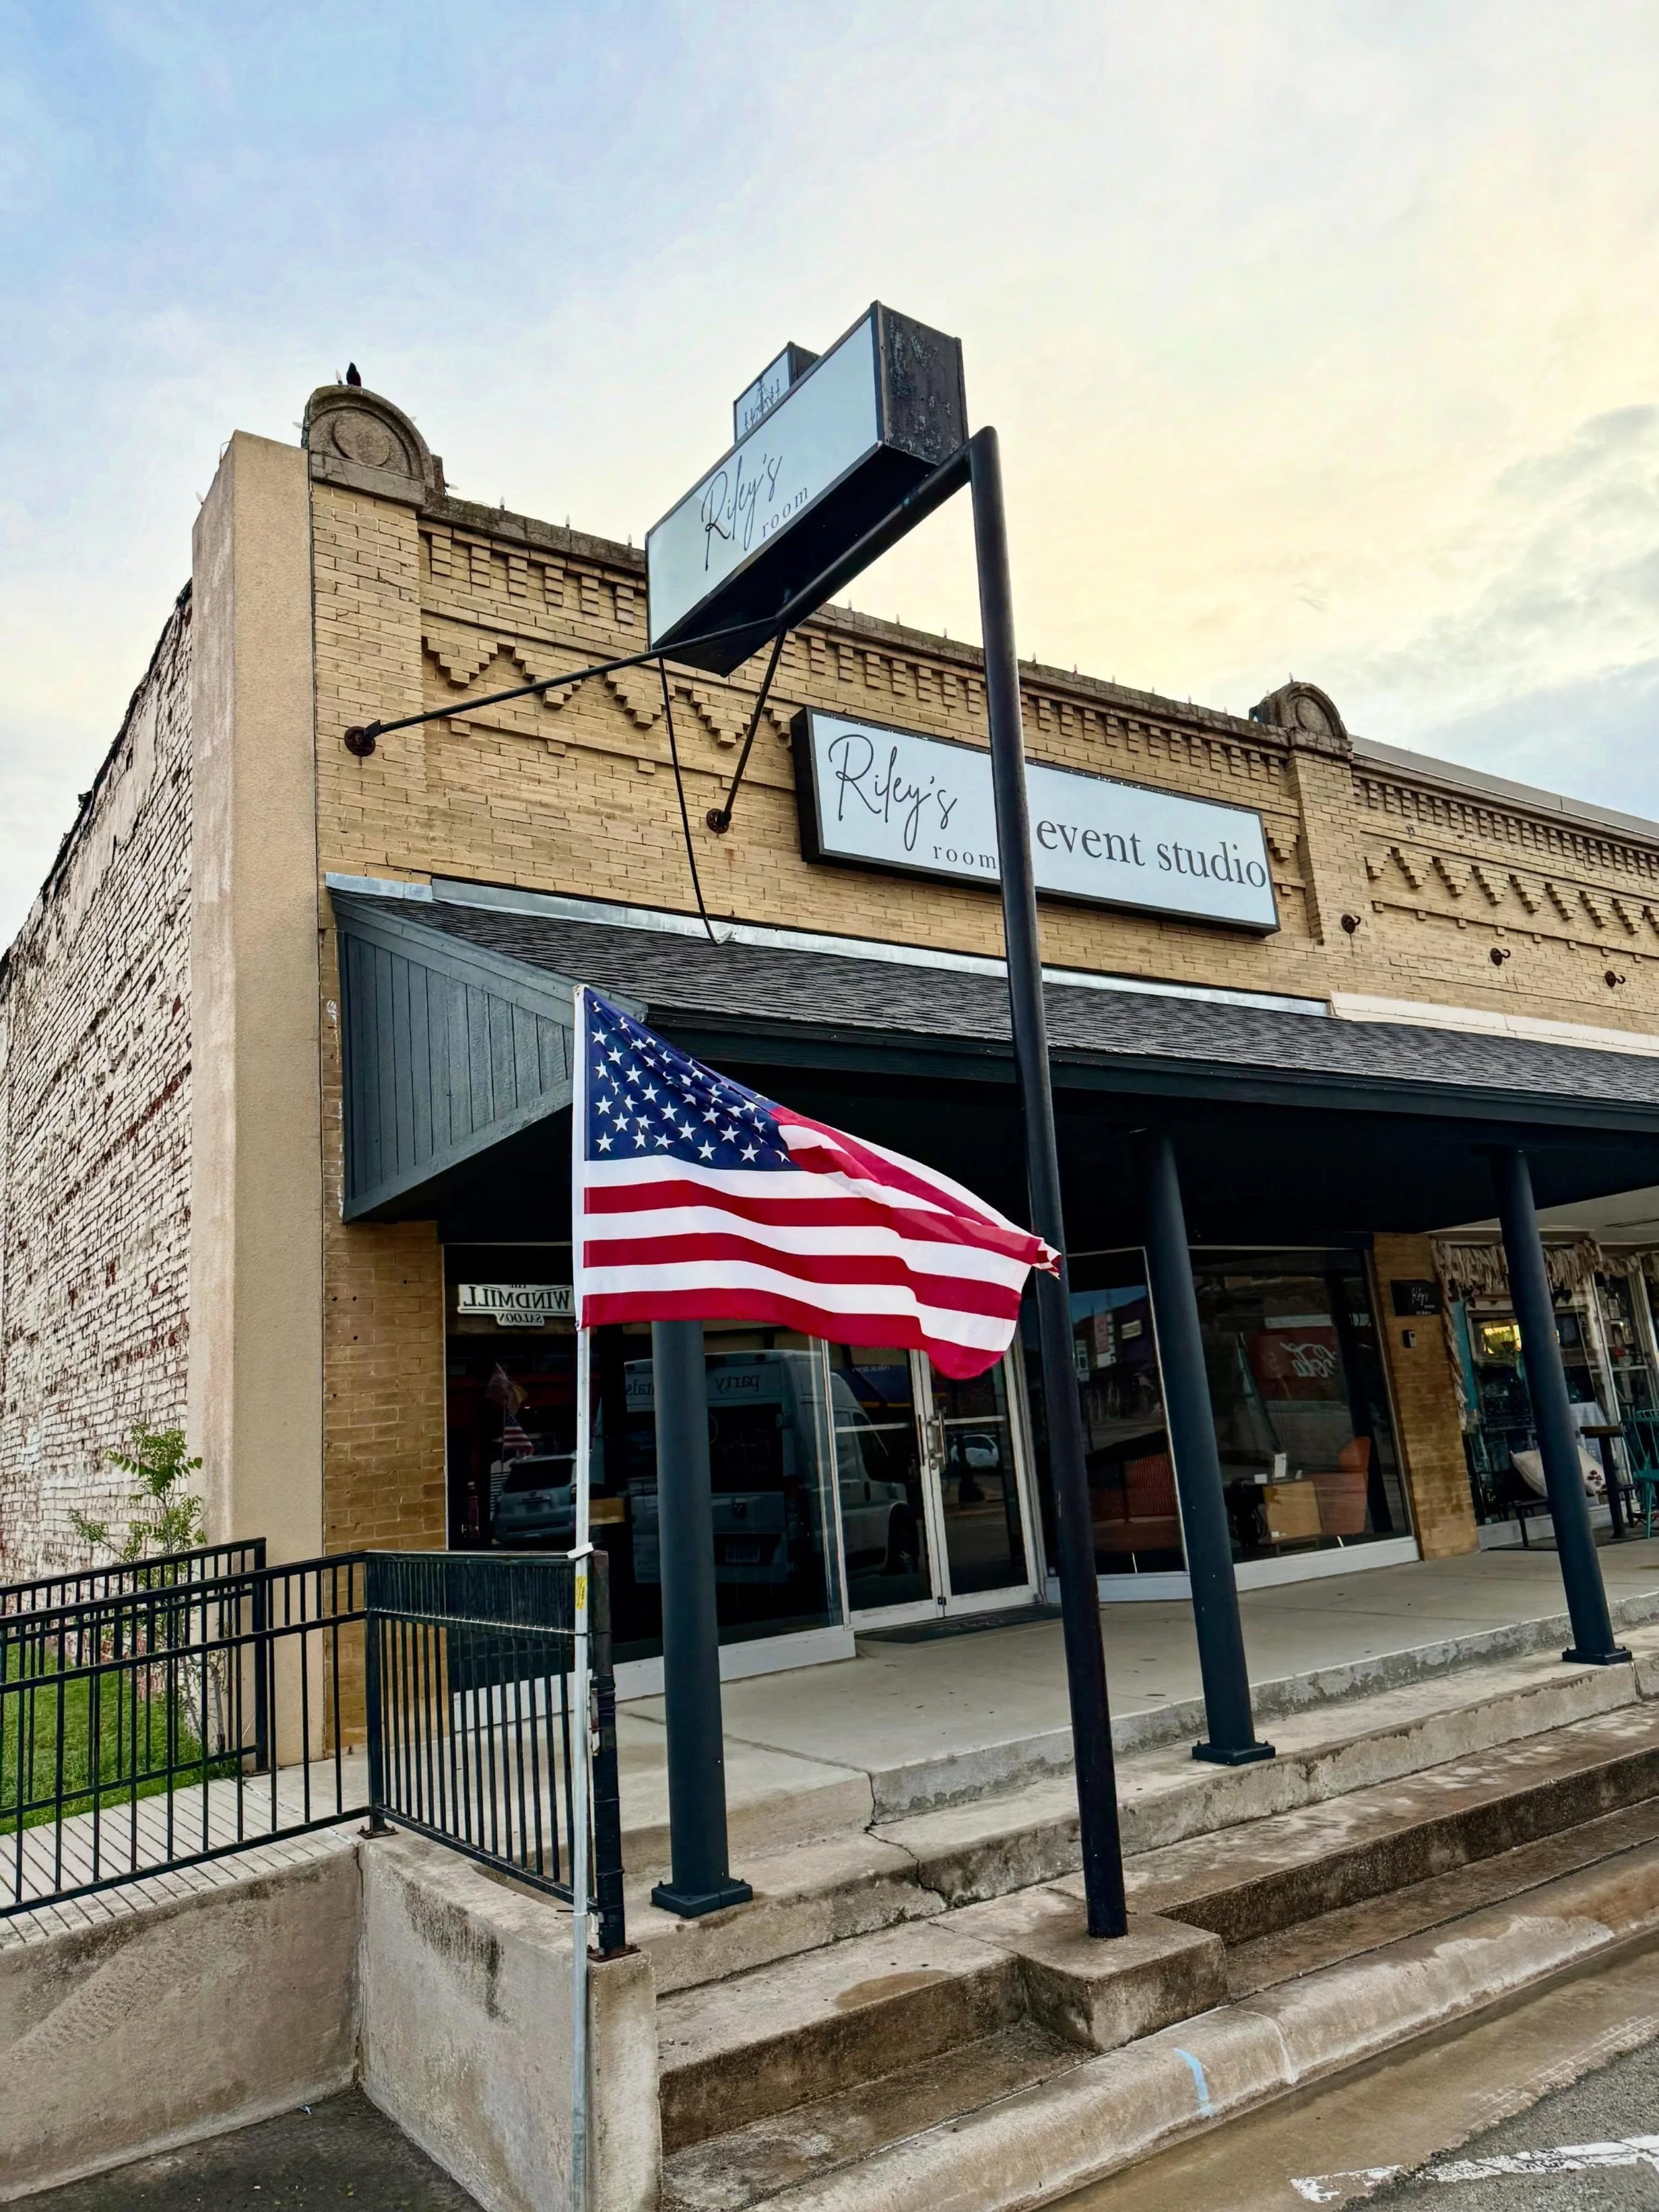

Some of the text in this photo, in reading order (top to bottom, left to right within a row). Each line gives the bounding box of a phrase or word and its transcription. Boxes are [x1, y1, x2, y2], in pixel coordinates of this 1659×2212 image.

[701, 454, 782, 572] Riley's
[762, 486, 809, 538] room
[828, 734, 958, 851] Riley's
[933, 846, 997, 869] room
[1037, 820, 1267, 888] event studio
